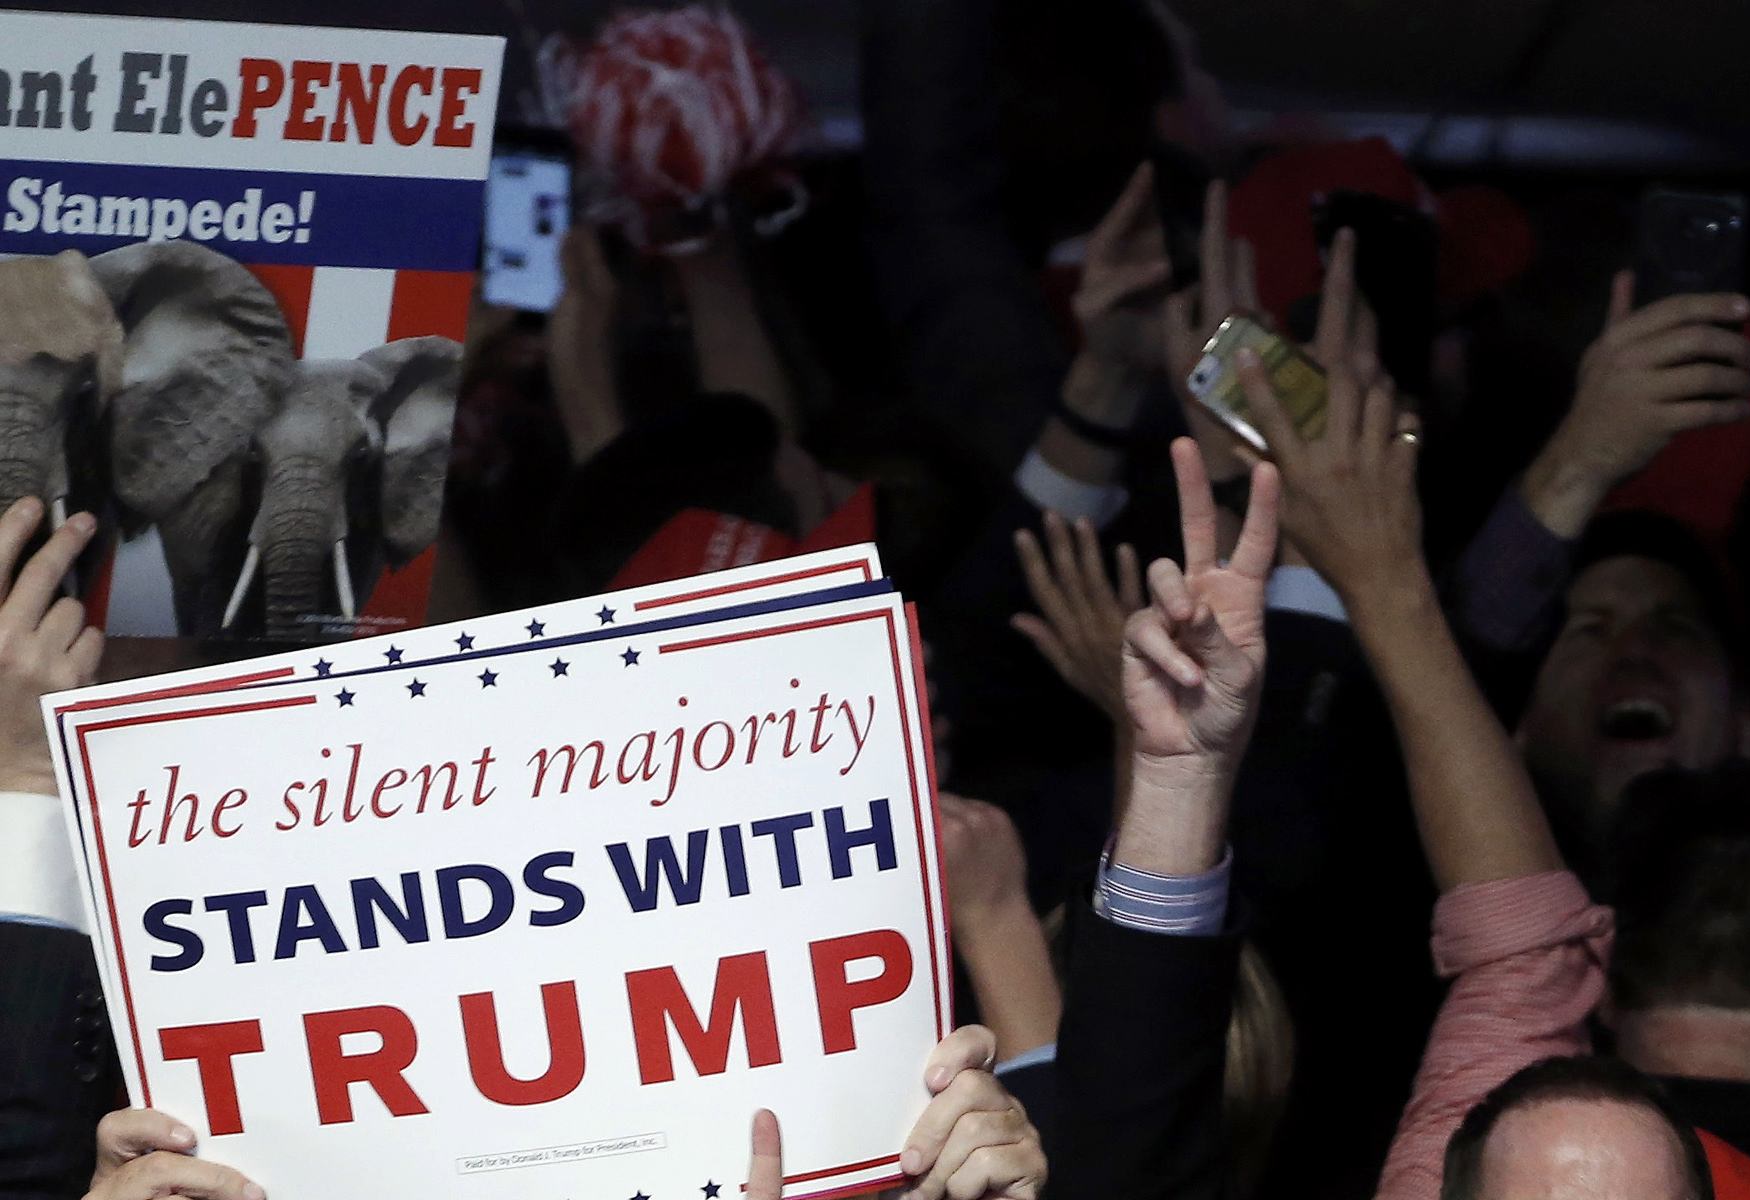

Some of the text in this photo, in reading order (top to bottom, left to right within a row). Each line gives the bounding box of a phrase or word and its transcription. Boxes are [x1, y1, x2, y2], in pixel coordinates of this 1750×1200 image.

[0, 52, 483, 148] nt ElePENCE
[3, 177, 316, 243] Stampede!
[127, 678, 875, 848] the silent majority
[143, 798, 898, 972] STANDS WITH
[158, 928, 914, 1137] TRUMP
